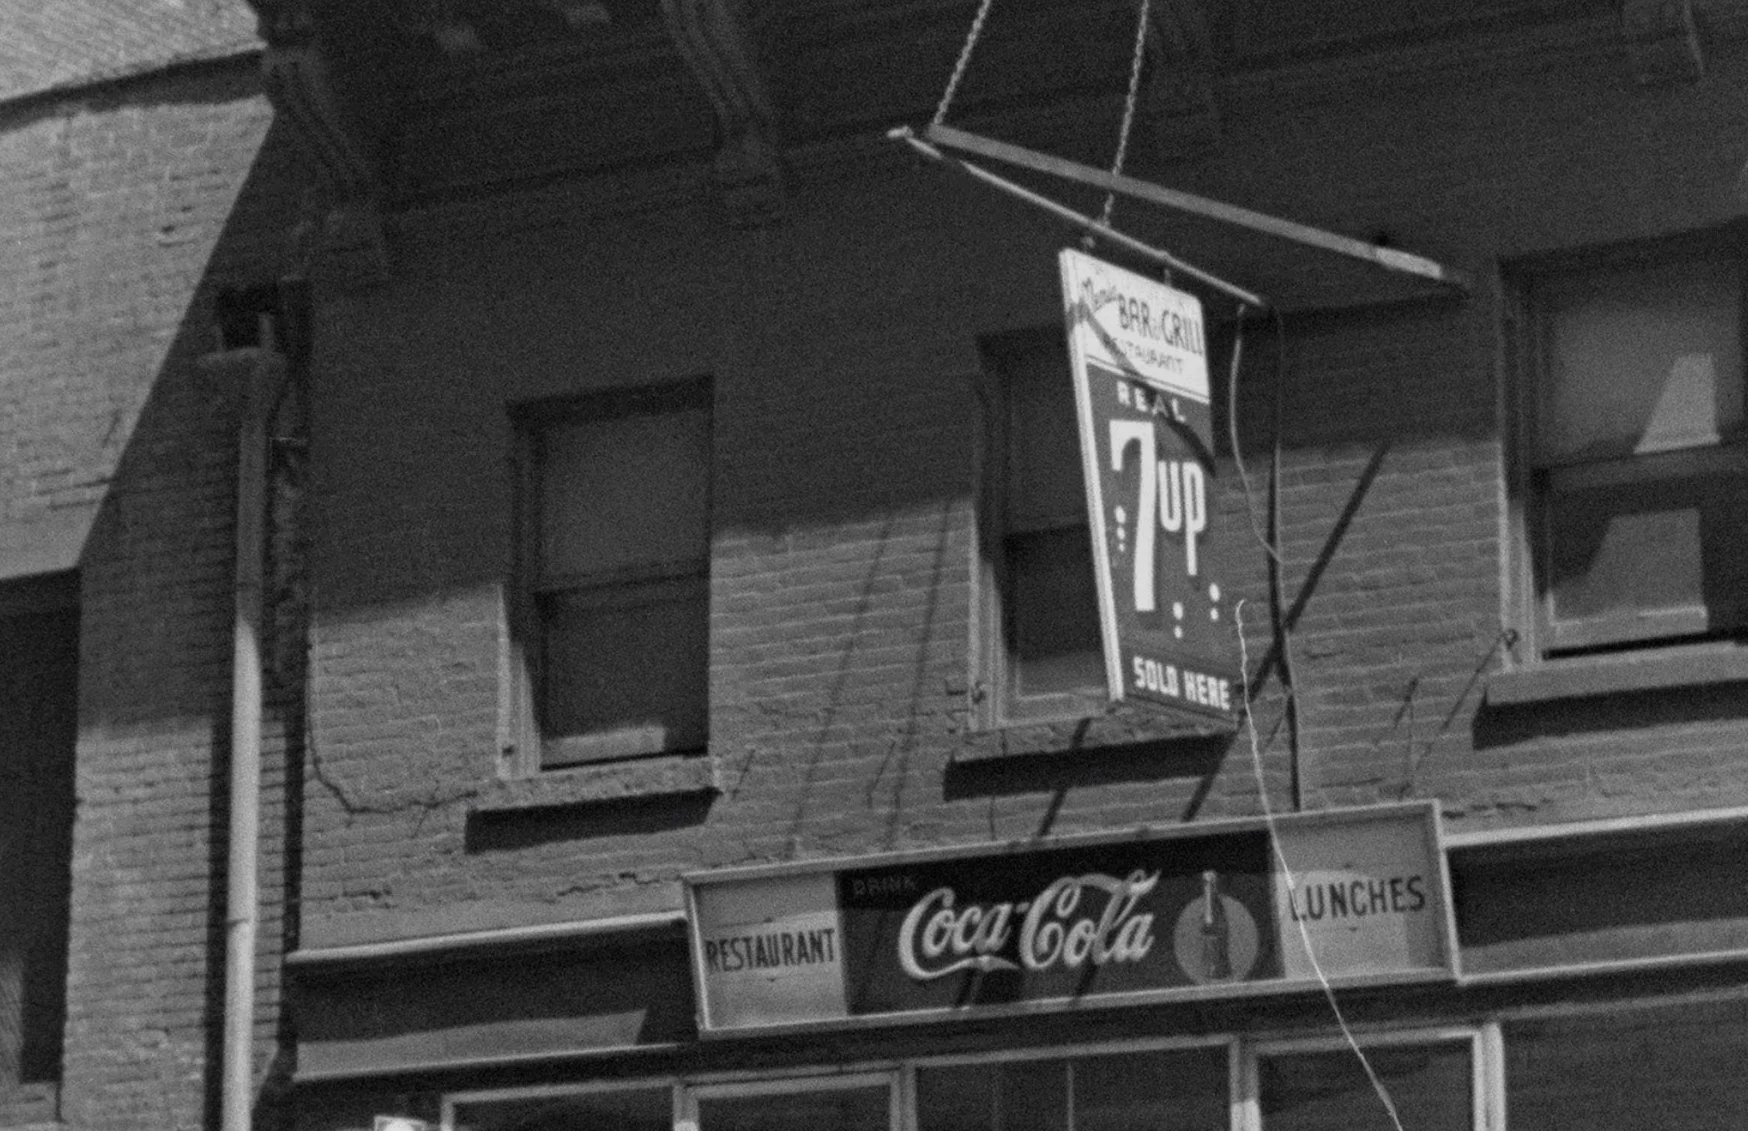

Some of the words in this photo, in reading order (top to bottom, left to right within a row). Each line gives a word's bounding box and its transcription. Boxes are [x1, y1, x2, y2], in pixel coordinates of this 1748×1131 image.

[1118, 293, 1153, 338] BAR
[1161, 310, 1203, 357] GRILL
[1117, 380, 1186, 422] REAL
[1133, 656, 1179, 697] SOLD
[1184, 669, 1231, 711] HERE
[1290, 875, 1426, 921] LUNCHES
[898, 868, 1161, 981] Coca-Cola
[705, 928, 836, 974] RESTAURANT
